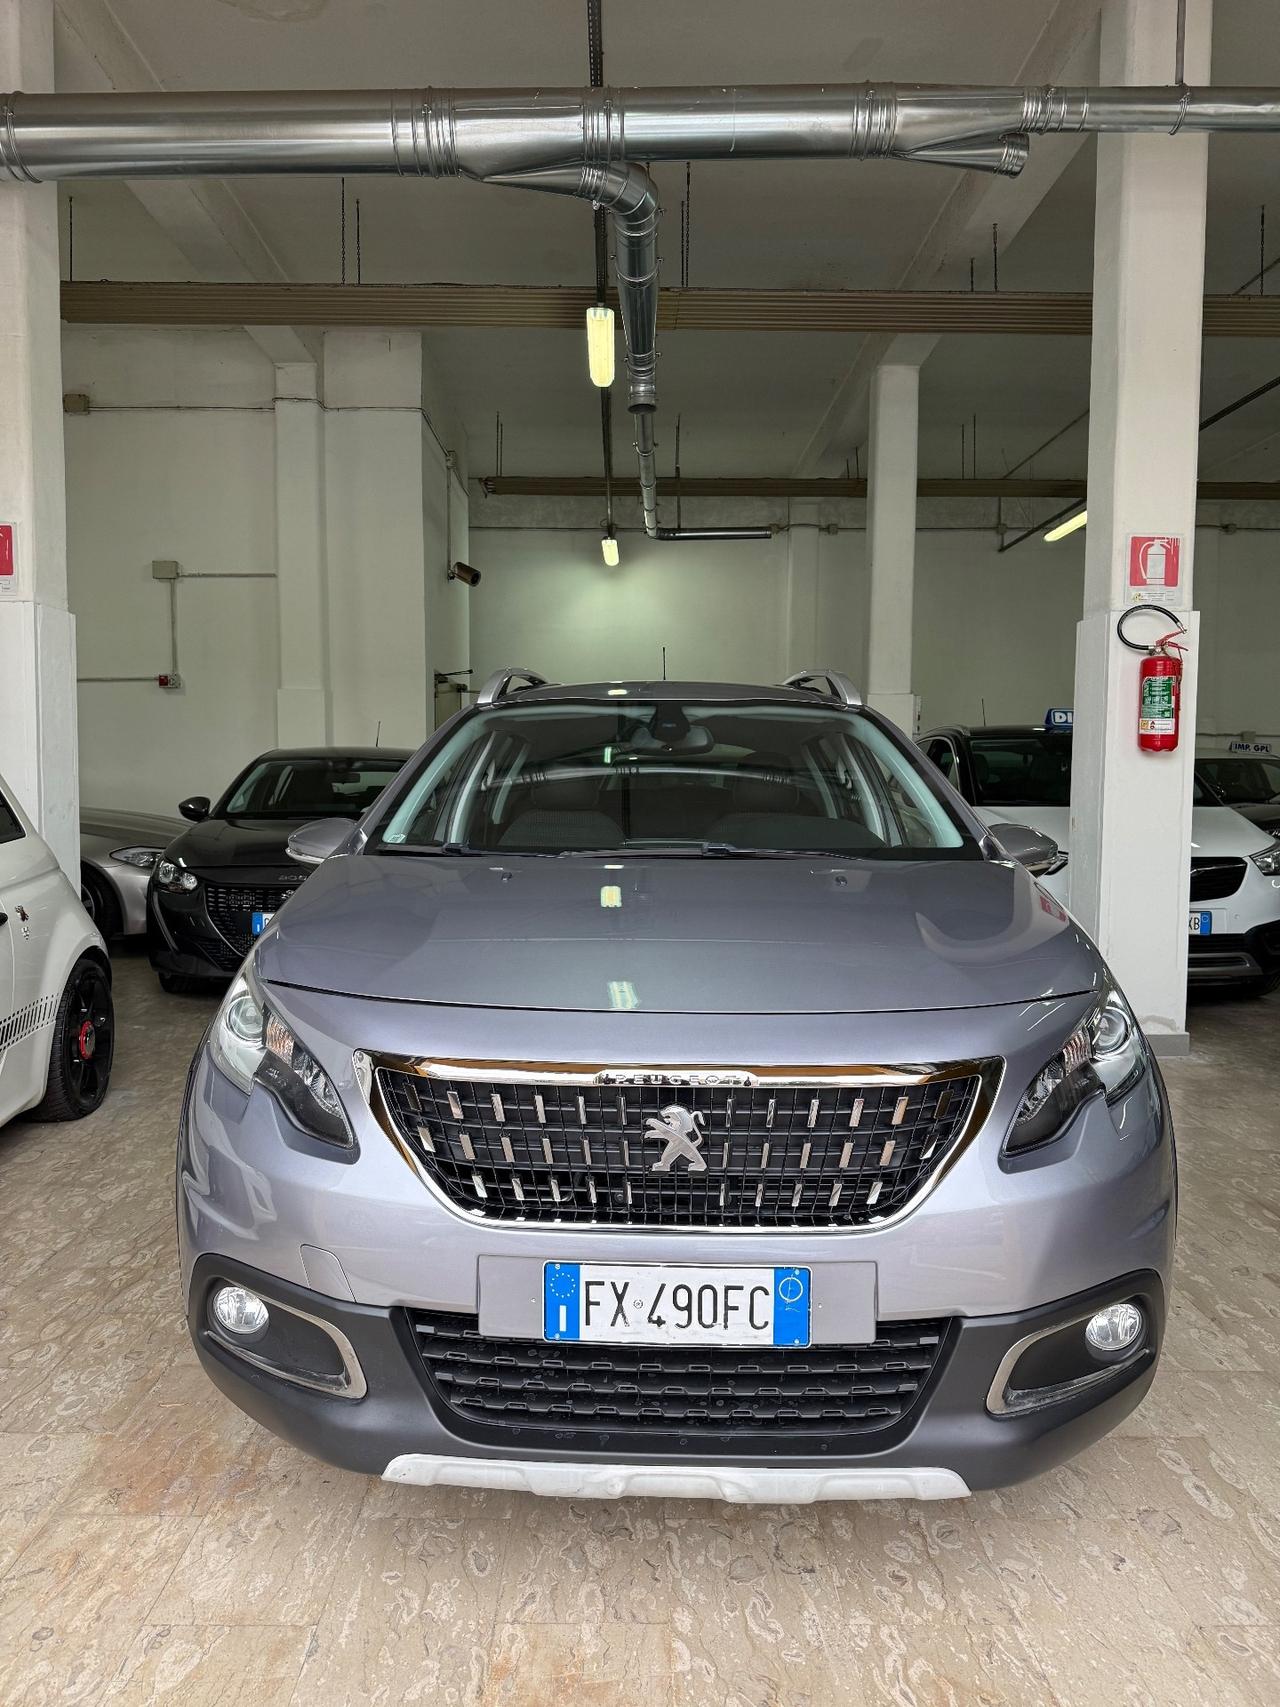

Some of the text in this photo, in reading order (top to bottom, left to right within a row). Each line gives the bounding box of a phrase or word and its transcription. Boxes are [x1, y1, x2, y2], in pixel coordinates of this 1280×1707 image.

[1253, 744, 1270, 753] GPL
[614, 1073, 739, 1086] PEUGEOT
[584, 1280, 770, 1331] FX 490FC
